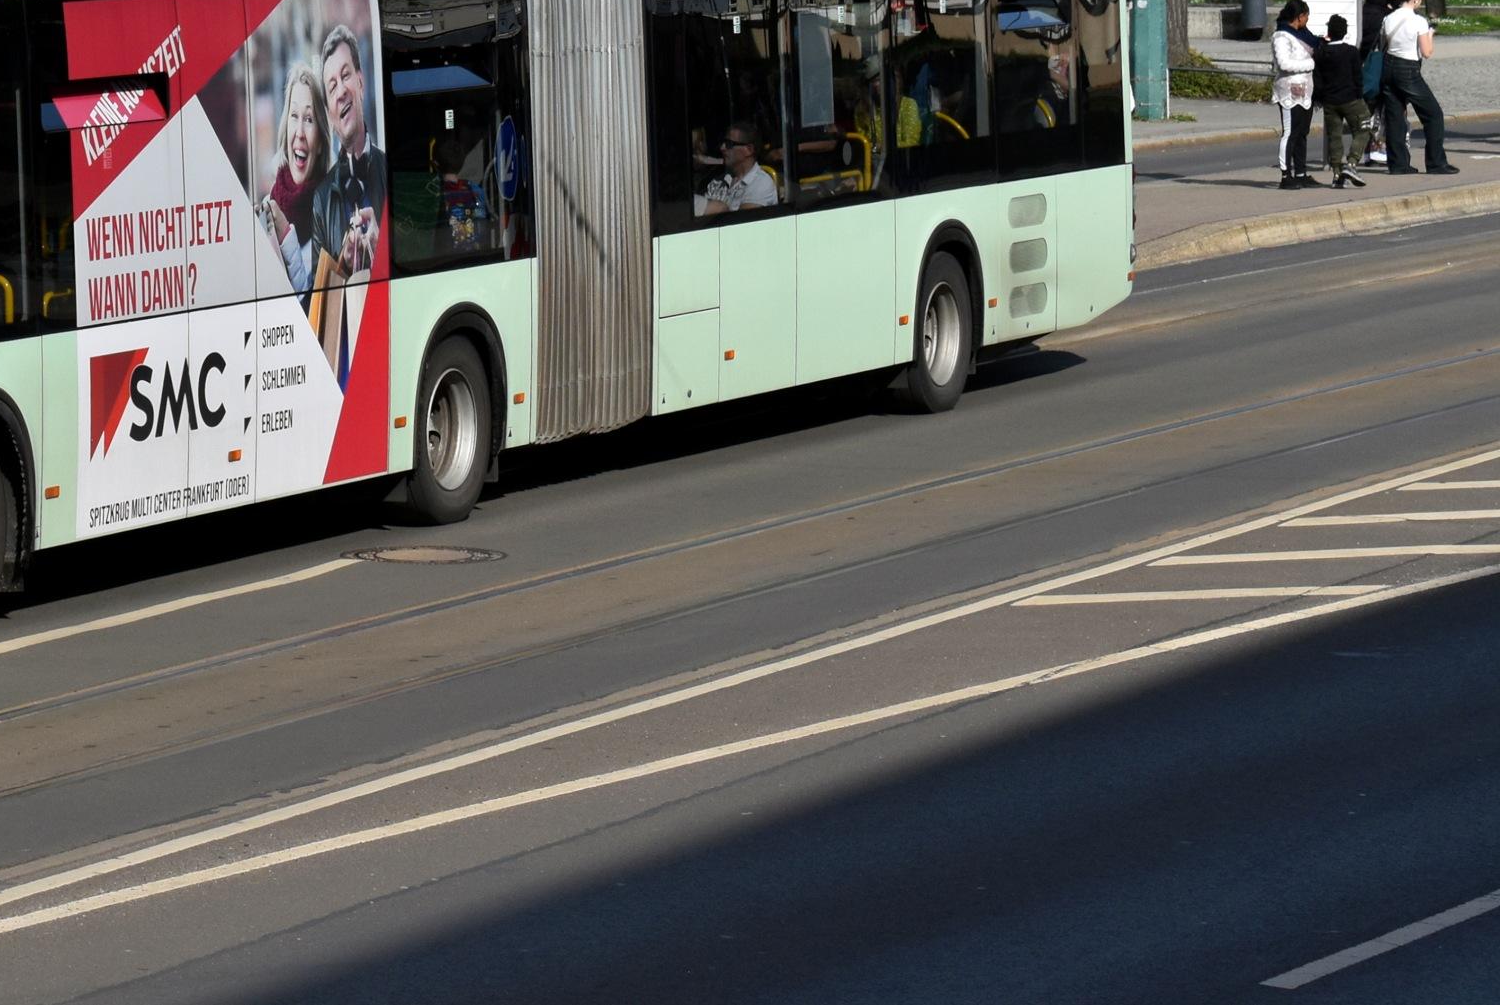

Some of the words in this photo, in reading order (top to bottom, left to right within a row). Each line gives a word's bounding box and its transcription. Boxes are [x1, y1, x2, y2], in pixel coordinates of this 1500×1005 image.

[86, 213, 135, 261] WENN
[138, 206, 186, 254] NICHT
[189, 200, 232, 247] JETZT
[88, 272, 136, 321] WANN
[141, 265, 184, 313] DANN
[188, 263, 197, 305] ?
[262, 324, 295, 348] SHOPPEN
[129, 352, 227, 442] SMC
[262, 364, 306, 391] SCHLEMMEN
[261, 409, 293, 434] ERLEBEN
[89, 501, 130, 528] SPITZKRUG
[131, 496, 153, 519] MULTI
[153, 489, 182, 514] CENTER
[182, 480, 224, 507] FRANKFURT
